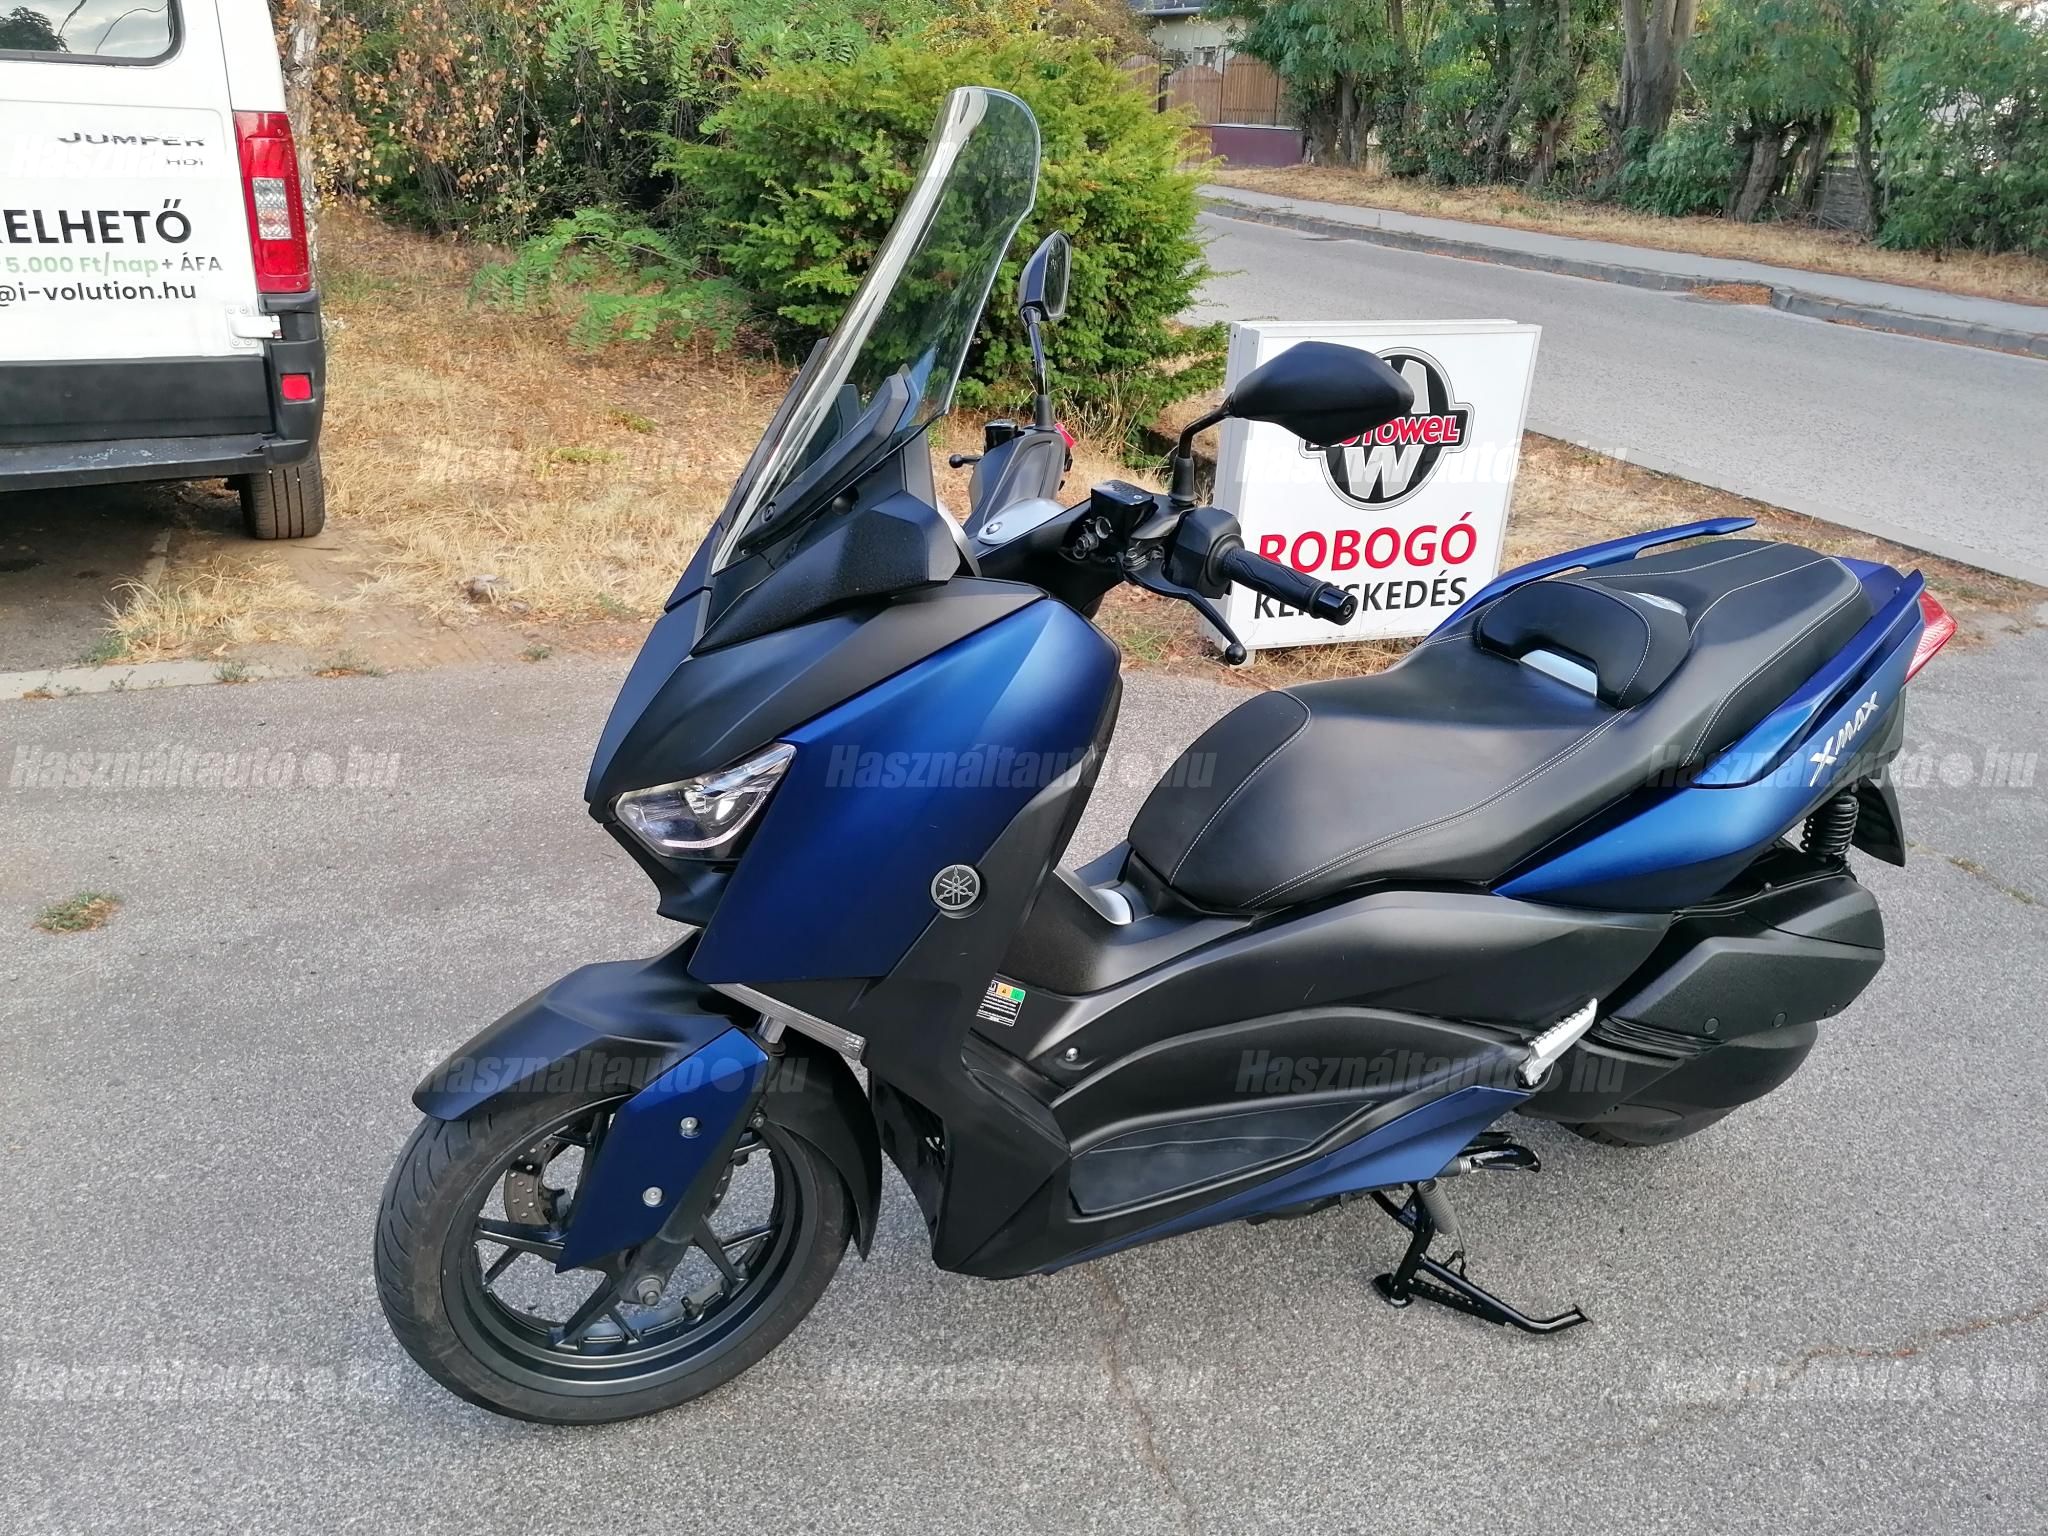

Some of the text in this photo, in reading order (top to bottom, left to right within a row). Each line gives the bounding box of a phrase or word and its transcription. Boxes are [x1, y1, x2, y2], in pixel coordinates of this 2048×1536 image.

[57, 132, 205, 147] JUMPER
[0, 198, 192, 244] ELHETŐ
[180, 251, 223, 271] ÁFA
[1258, 511, 1478, 574] ROBOGÓ
